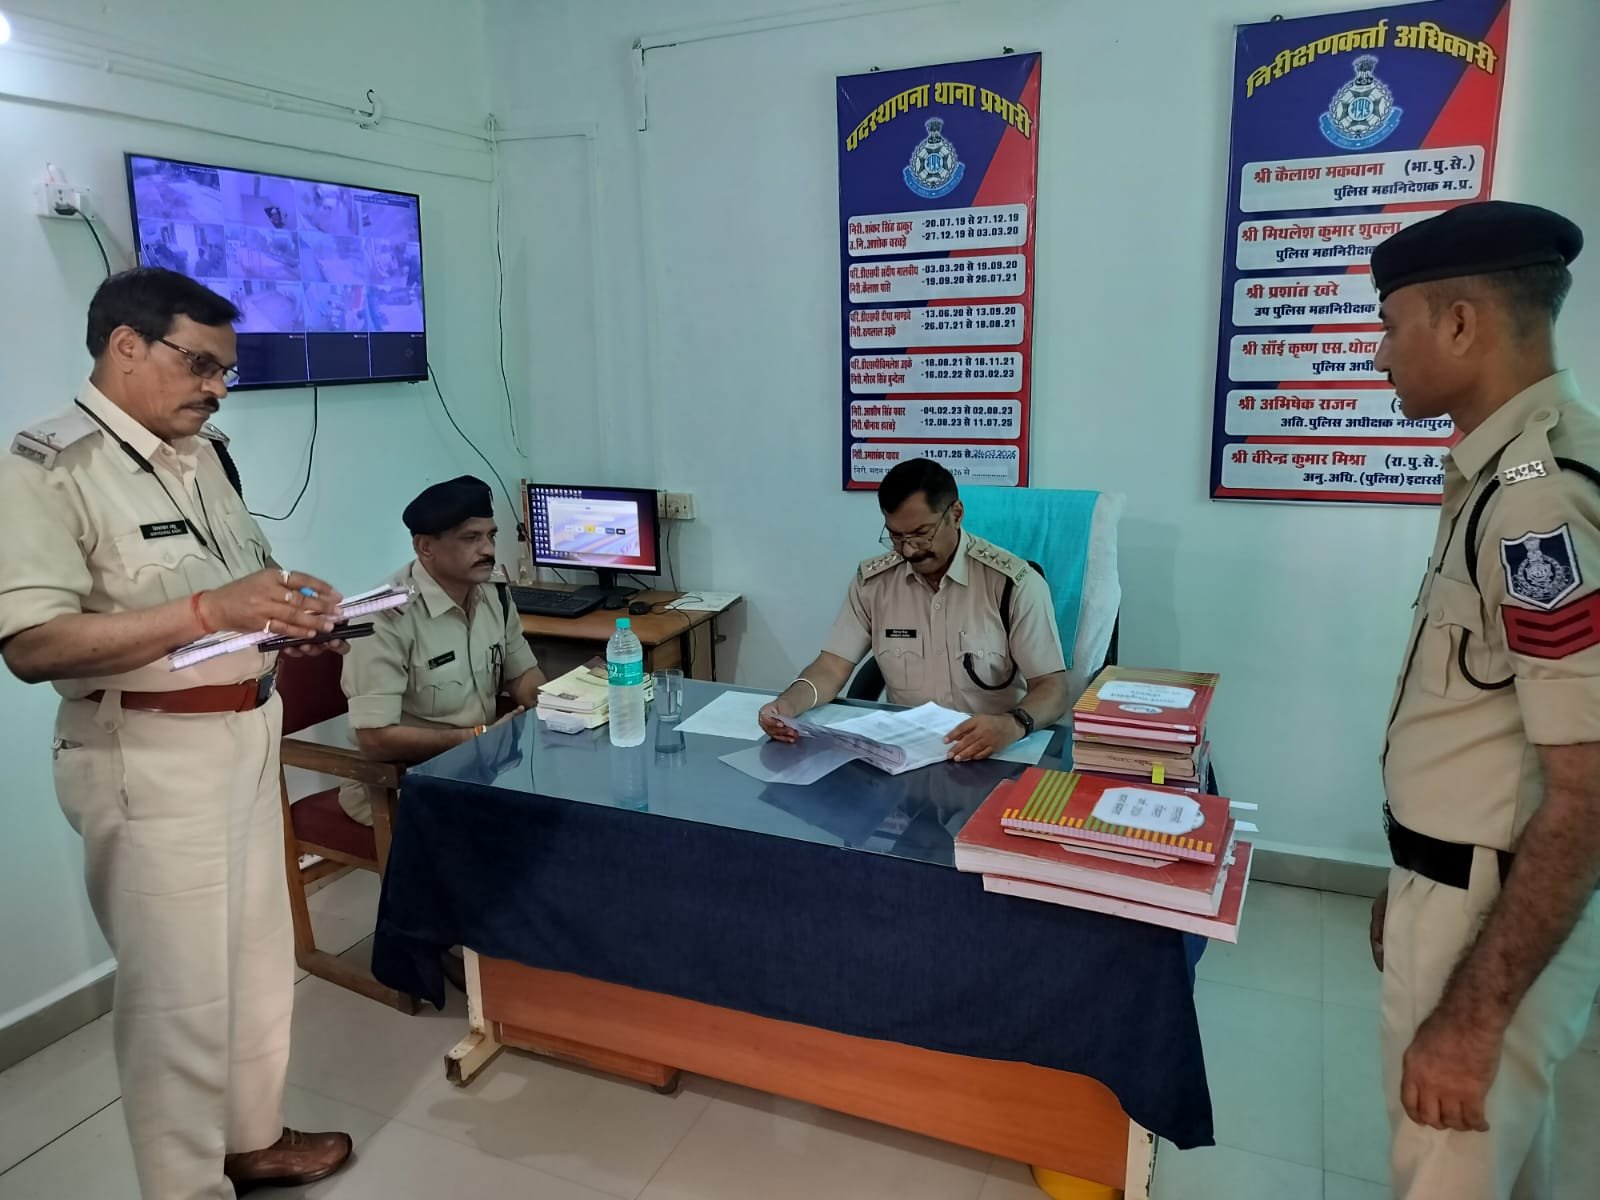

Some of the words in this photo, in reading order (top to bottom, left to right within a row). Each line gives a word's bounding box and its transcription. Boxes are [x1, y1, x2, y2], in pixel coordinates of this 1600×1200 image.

[1246, 19, 1389, 98] निरीक्षणकर्ता
[1394, 20, 1499, 75] अधिकारी
[845, 82, 931, 153] पदस्थापना
[933, 81, 977, 107] थाना
[980, 86, 1033, 140] प्रभारी
[1254, 167, 1272, 184] श्री
[1275, 164, 1321, 182] कैलाश
[1326, 162, 1385, 178] मकवाना
[1404, 154, 1475, 177] (भा.पु.से.)
[1334, 184, 1368, 201] पुलिस
[1372, 180, 1440, 196] महानिदेशक
[1442, 179, 1473, 192] म.प्र.
[896, 221, 913, 235] ठाकुर
[968, 214, 975, 225] से
[976, 213, 1019, 224] 27.12.19
[967, 227, 975, 238] से
[976, 226, 1019, 237] 03.03.20
[1242, 227, 1257, 241] श्री
[1262, 222, 1315, 241] मिथलेश
[1318, 223, 1354, 243] कुमार
[1359, 221, 1402, 243] शुक्ला
[1276, 248, 1309, 263] पुलिस
[967, 261, 974, 271] से
[977, 260, 1018, 271] 19.09.20
[966, 273, 974, 284] से
[975, 273, 1017, 284] 26.07.21
[1247, 284, 1263, 299] श्री
[1268, 281, 1308, 299] प्रशांत
[1314, 280, 1339, 297] खरे
[965, 306, 973, 317] से
[976, 306, 1016, 316] 13.09.20
[1255, 306, 1269, 317] उप
[1273, 303, 1305, 319] पुलिस
[1309, 301, 1377, 315] महानिरीक्षक
[965, 318, 973, 329] से
[1242, 341, 1257, 355] श्री
[1288, 342, 1318, 358] कृष्ण
[965, 356, 972, 366] से
[1312, 360, 1346, 375] पुलिस
[964, 368, 972, 379] से
[973, 369, 1015, 378] 03.02.23
[963, 404, 971, 415] से
[1238, 395, 1256, 410] श्री
[1260, 395, 1316, 410] अभिषेक
[1319, 398, 1358, 410] राजन
[963, 416, 971, 427] से
[973, 418, 1013, 427] 11.07.25
[1280, 415, 1343, 430] अति.पुलिस
[1345, 416, 1394, 428] अधीक्षक
[1231, 450, 1248, 464] श्री
[1252, 449, 1288, 465] वीरेन्द्र
[1291, 452, 1328, 468] कुमार
[1332, 451, 1367, 466] मिश्रा
